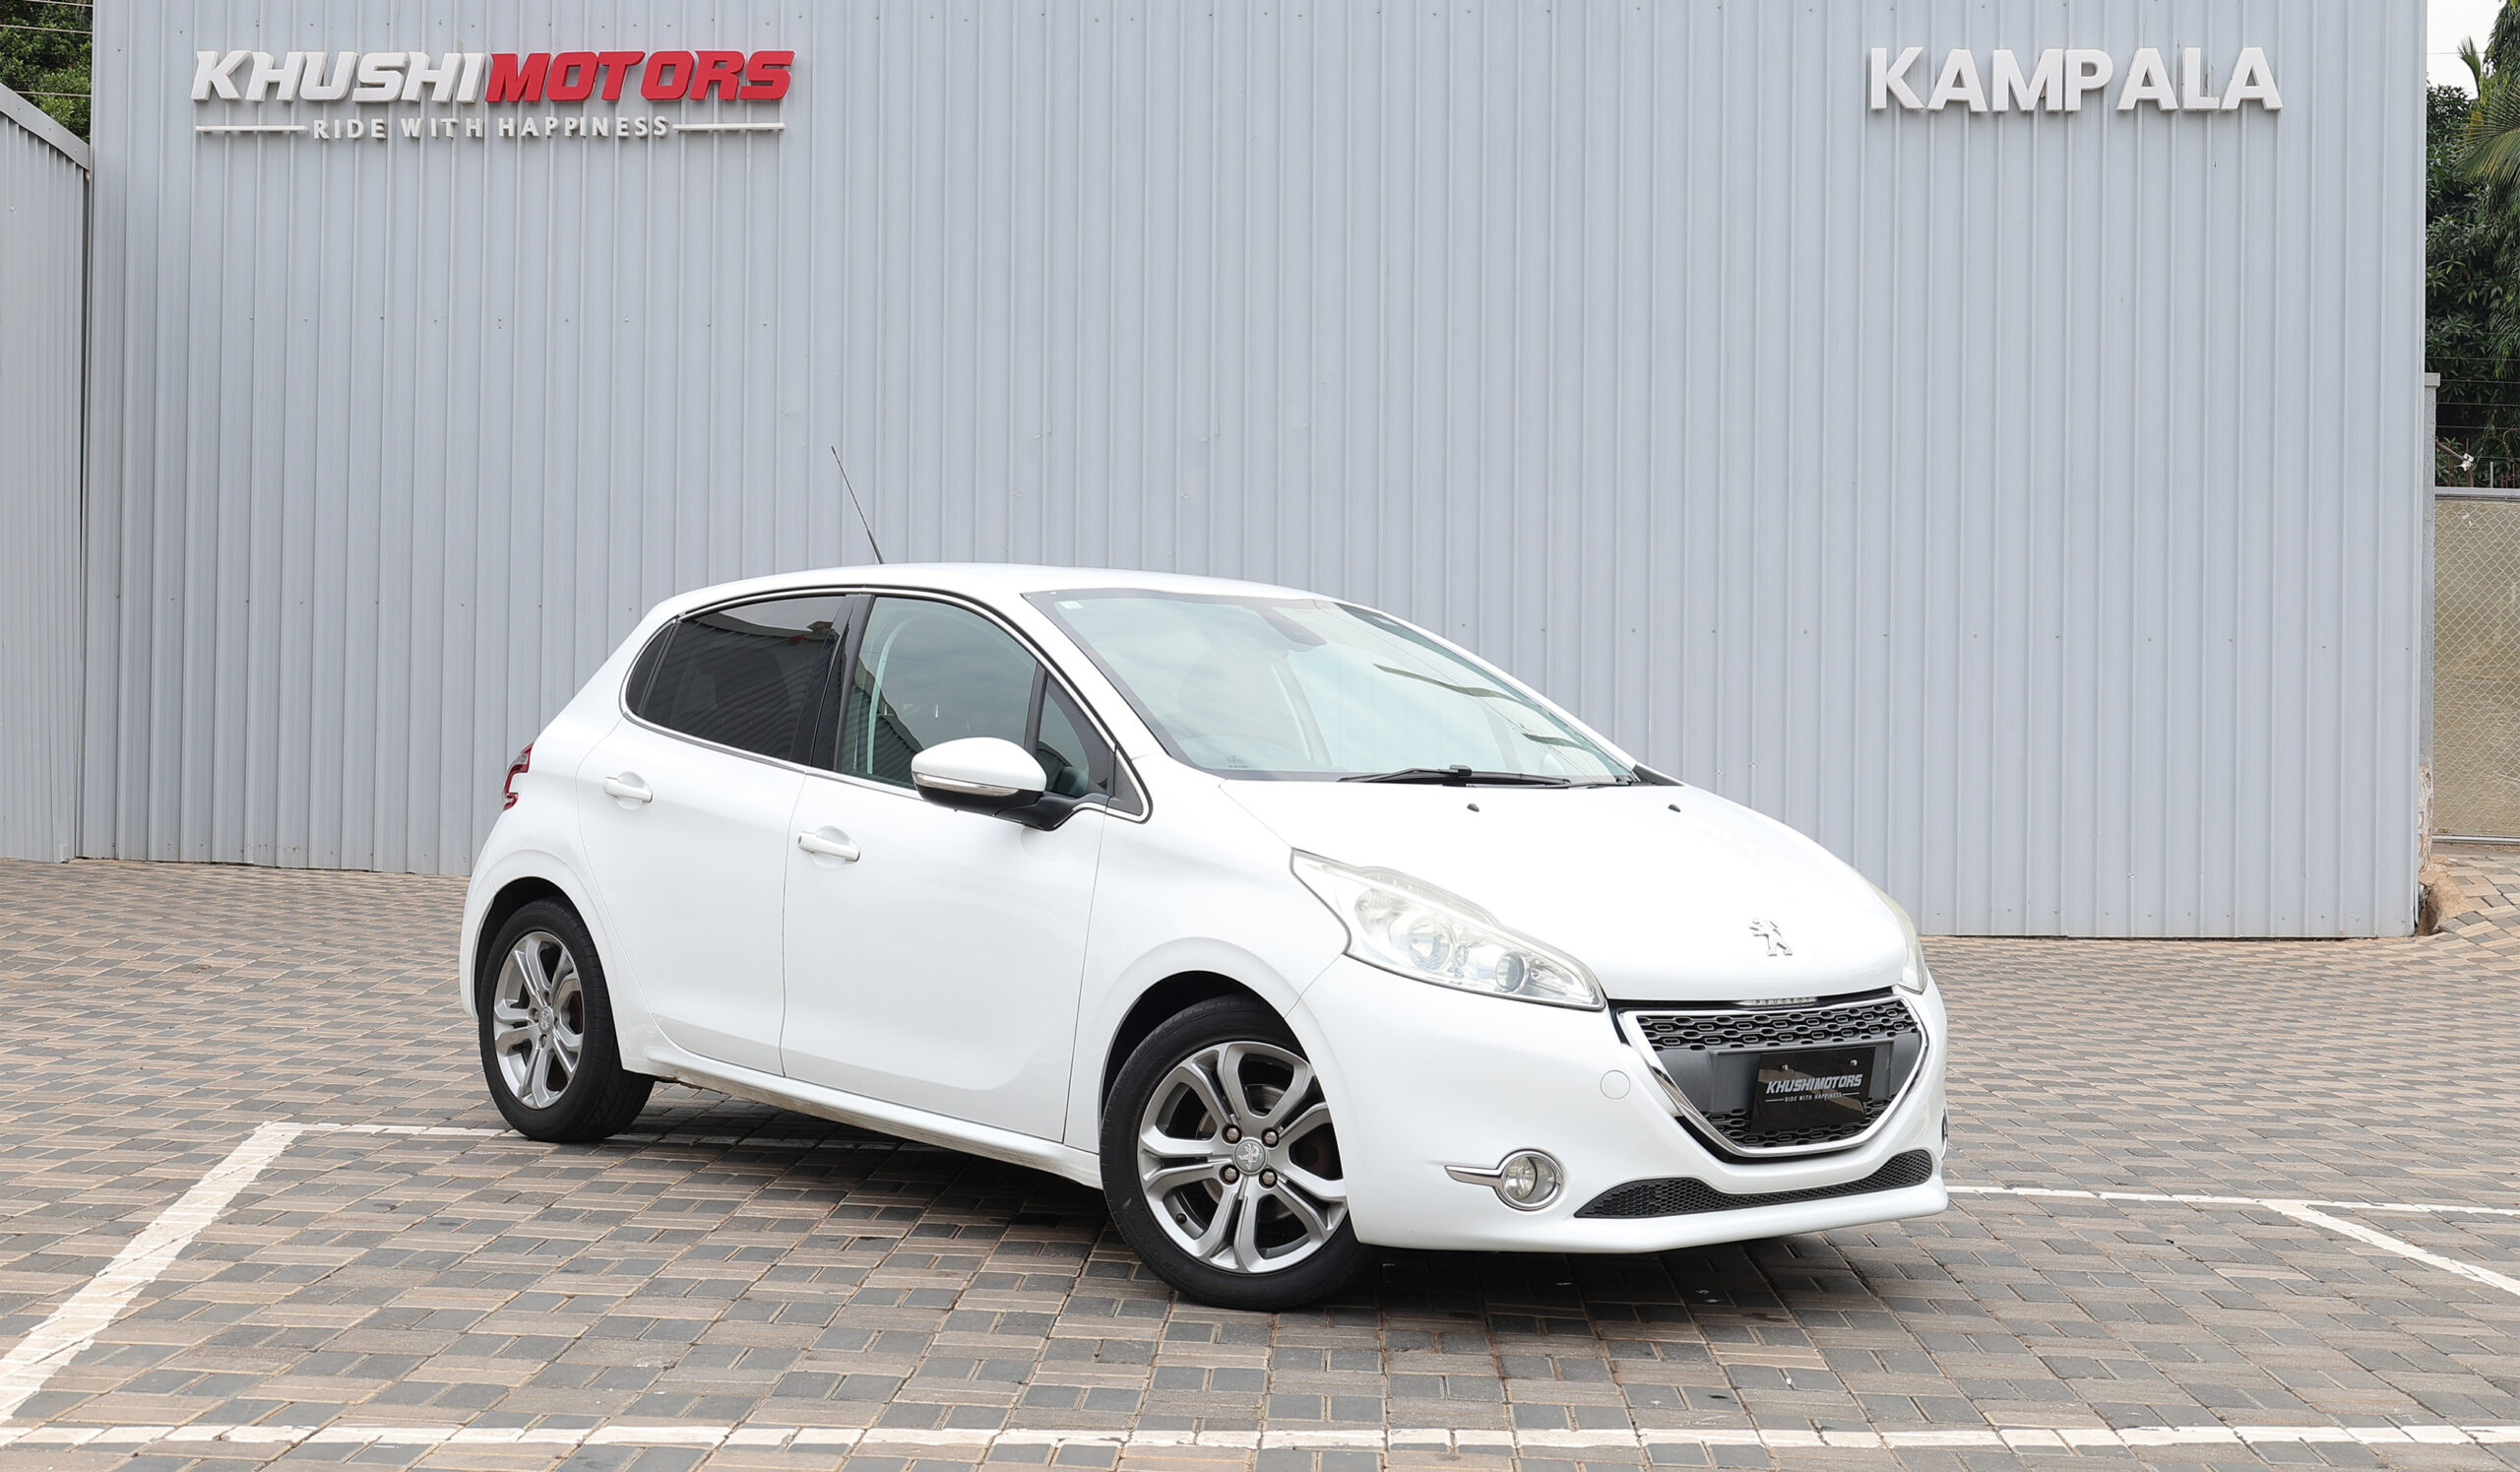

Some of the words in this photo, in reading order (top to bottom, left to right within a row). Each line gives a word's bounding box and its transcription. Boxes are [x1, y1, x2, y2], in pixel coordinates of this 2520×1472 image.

[191, 50, 794, 103] KHUSHIMOTORS
[1870, 47, 2283, 113] KAMPALA
[313, 118, 387, 140] RIDE
[400, 118, 484, 139] WITH
[498, 115, 669, 138] HAPPINESS
